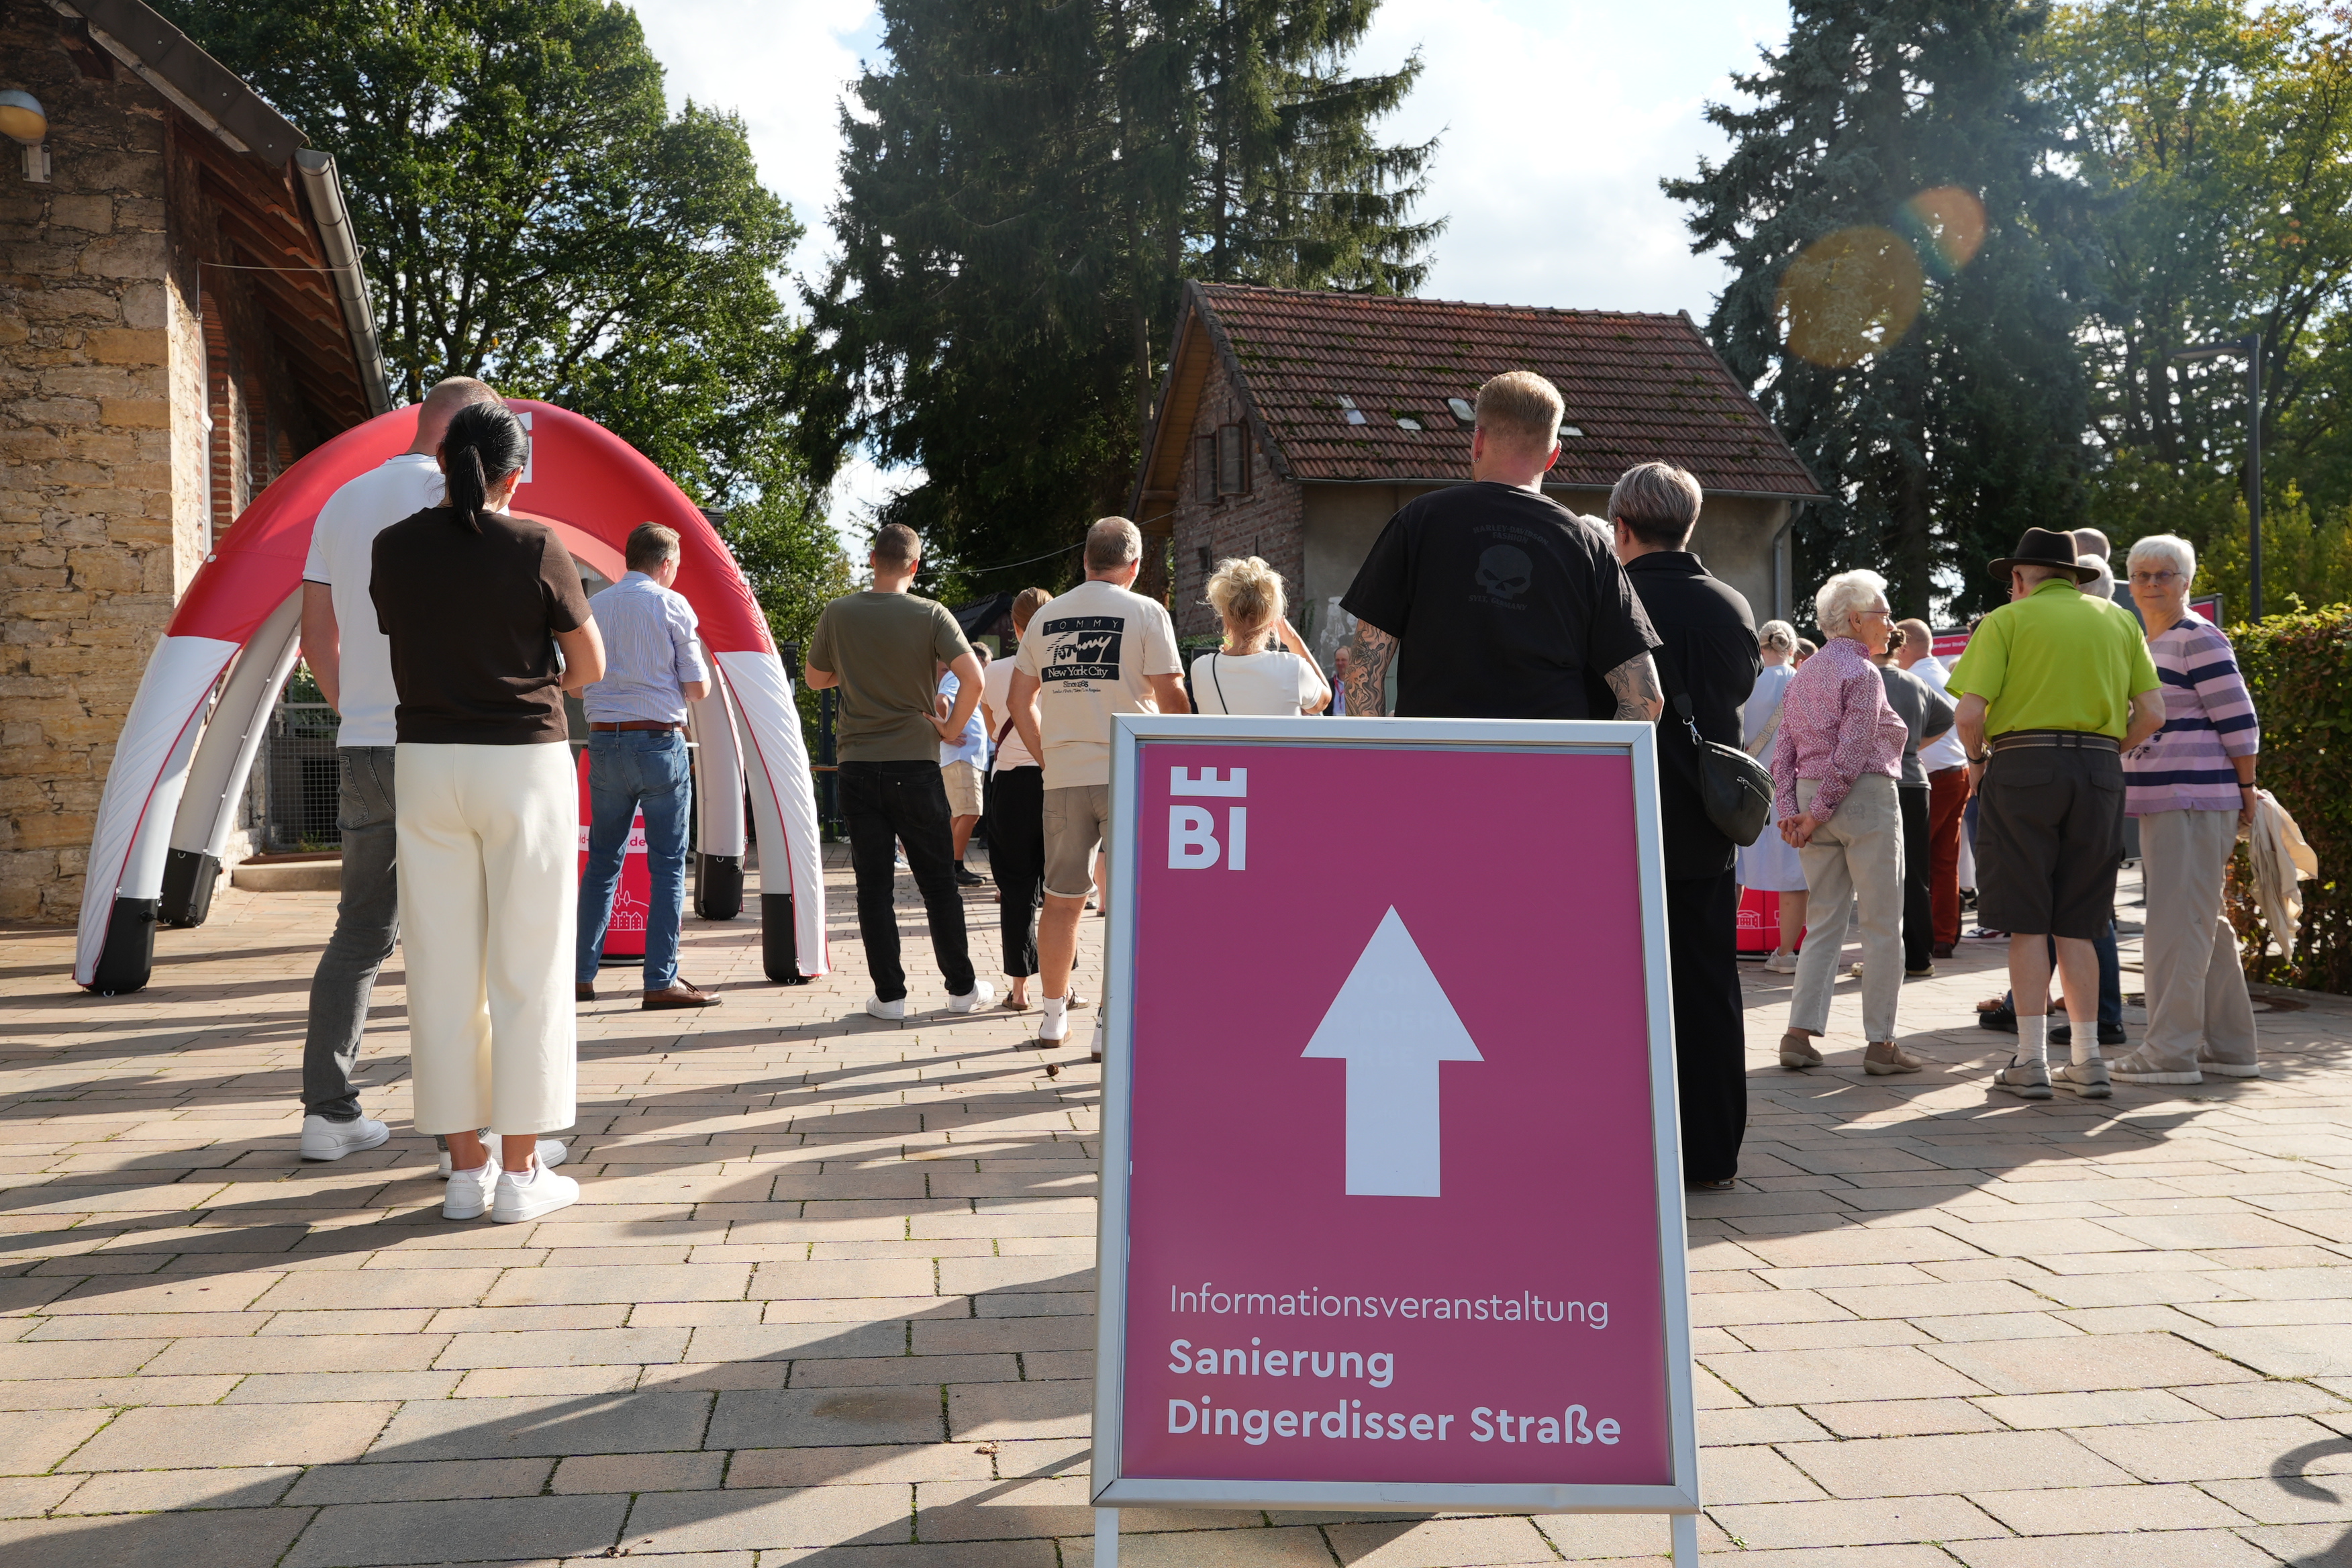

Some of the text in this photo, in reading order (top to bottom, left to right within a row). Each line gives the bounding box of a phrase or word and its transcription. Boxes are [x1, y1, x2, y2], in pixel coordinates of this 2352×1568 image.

[1473, 524, 1549, 546] HARLEY-DAVIDSON
[1492, 532, 1529, 544] FASHION
[1468, 595, 1528, 611] SYLT, GERMANY
[1047, 619, 1118, 632] TOMMY
[1048, 665, 1108, 678] New York City
[1171, 1282, 1609, 1330] Informationsveranstaltung
[1167, 1336, 1394, 1388] Sanierung
[1168, 1395, 1622, 1446] Dingerdisser Straße
